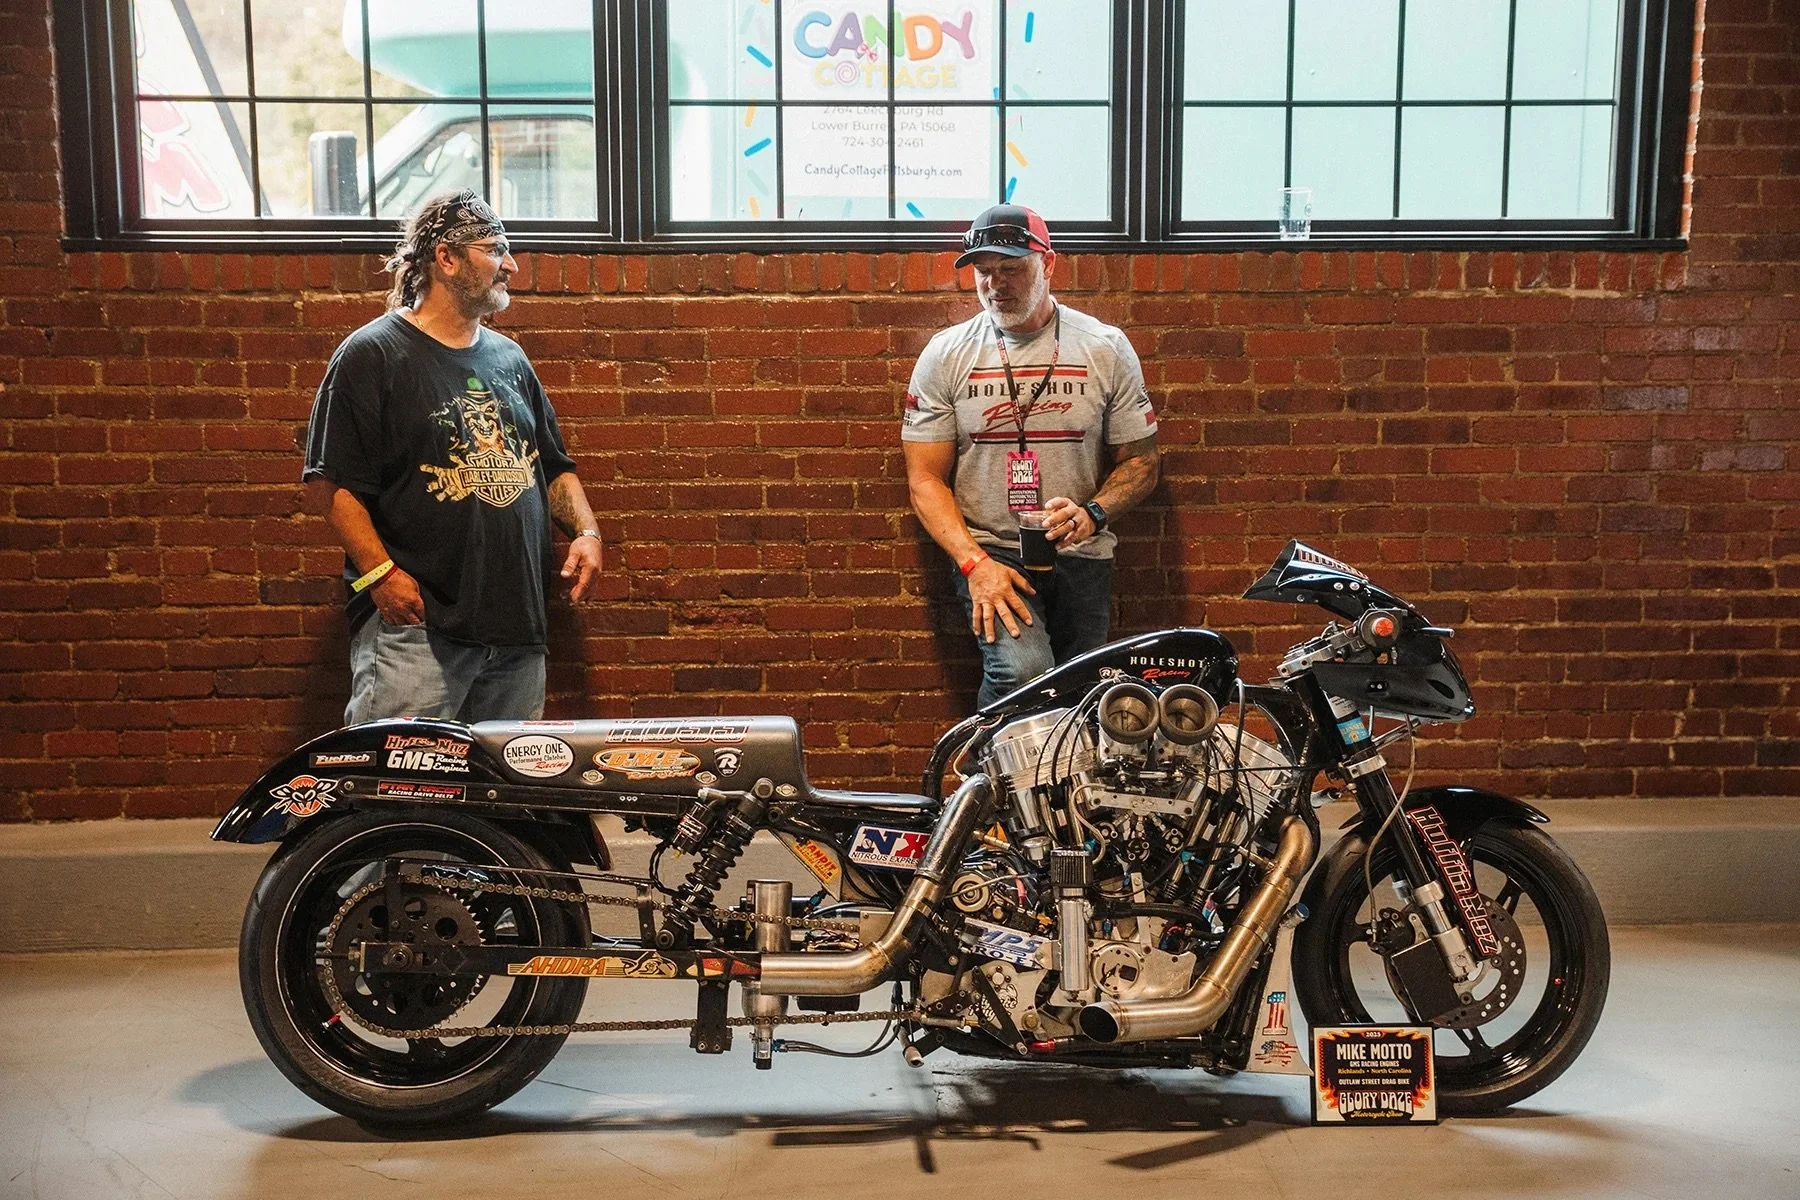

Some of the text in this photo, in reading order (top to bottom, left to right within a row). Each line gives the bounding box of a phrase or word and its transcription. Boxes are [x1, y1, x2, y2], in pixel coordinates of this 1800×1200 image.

[793, 11, 975, 61] CANDY
[814, 60, 957, 88] COTTAGE
[811, 121, 848, 131] Lower
[901, 122, 917, 131] PA
[921, 122, 956, 132] 15068
[968, 380, 1088, 399] HOLESHOT
[475, 458, 510, 468] MOTOR
[1012, 460, 1034, 471] GLORY
[463, 469, 527, 483] HARLEY-DAVIDSON
[1012, 471, 1034, 484] DAZE
[480, 485, 515, 501] CYCLES
[1130, 656, 1206, 668] HOLESHOT
[1142, 668, 1191, 681] Racing
[506, 742, 564, 759] ENERGY ONE
[316, 753, 370, 766] FuelTech
[386, 749, 468, 771] GMS Racing
[855, 828, 933, 858] NX
[851, 852, 888, 862] NITROUS
[520, 956, 606, 975] AHDRA
[1336, 1043, 1412, 1060] MIKE MOTTO
[1339, 1091, 1413, 1114] GLORY DAZE
